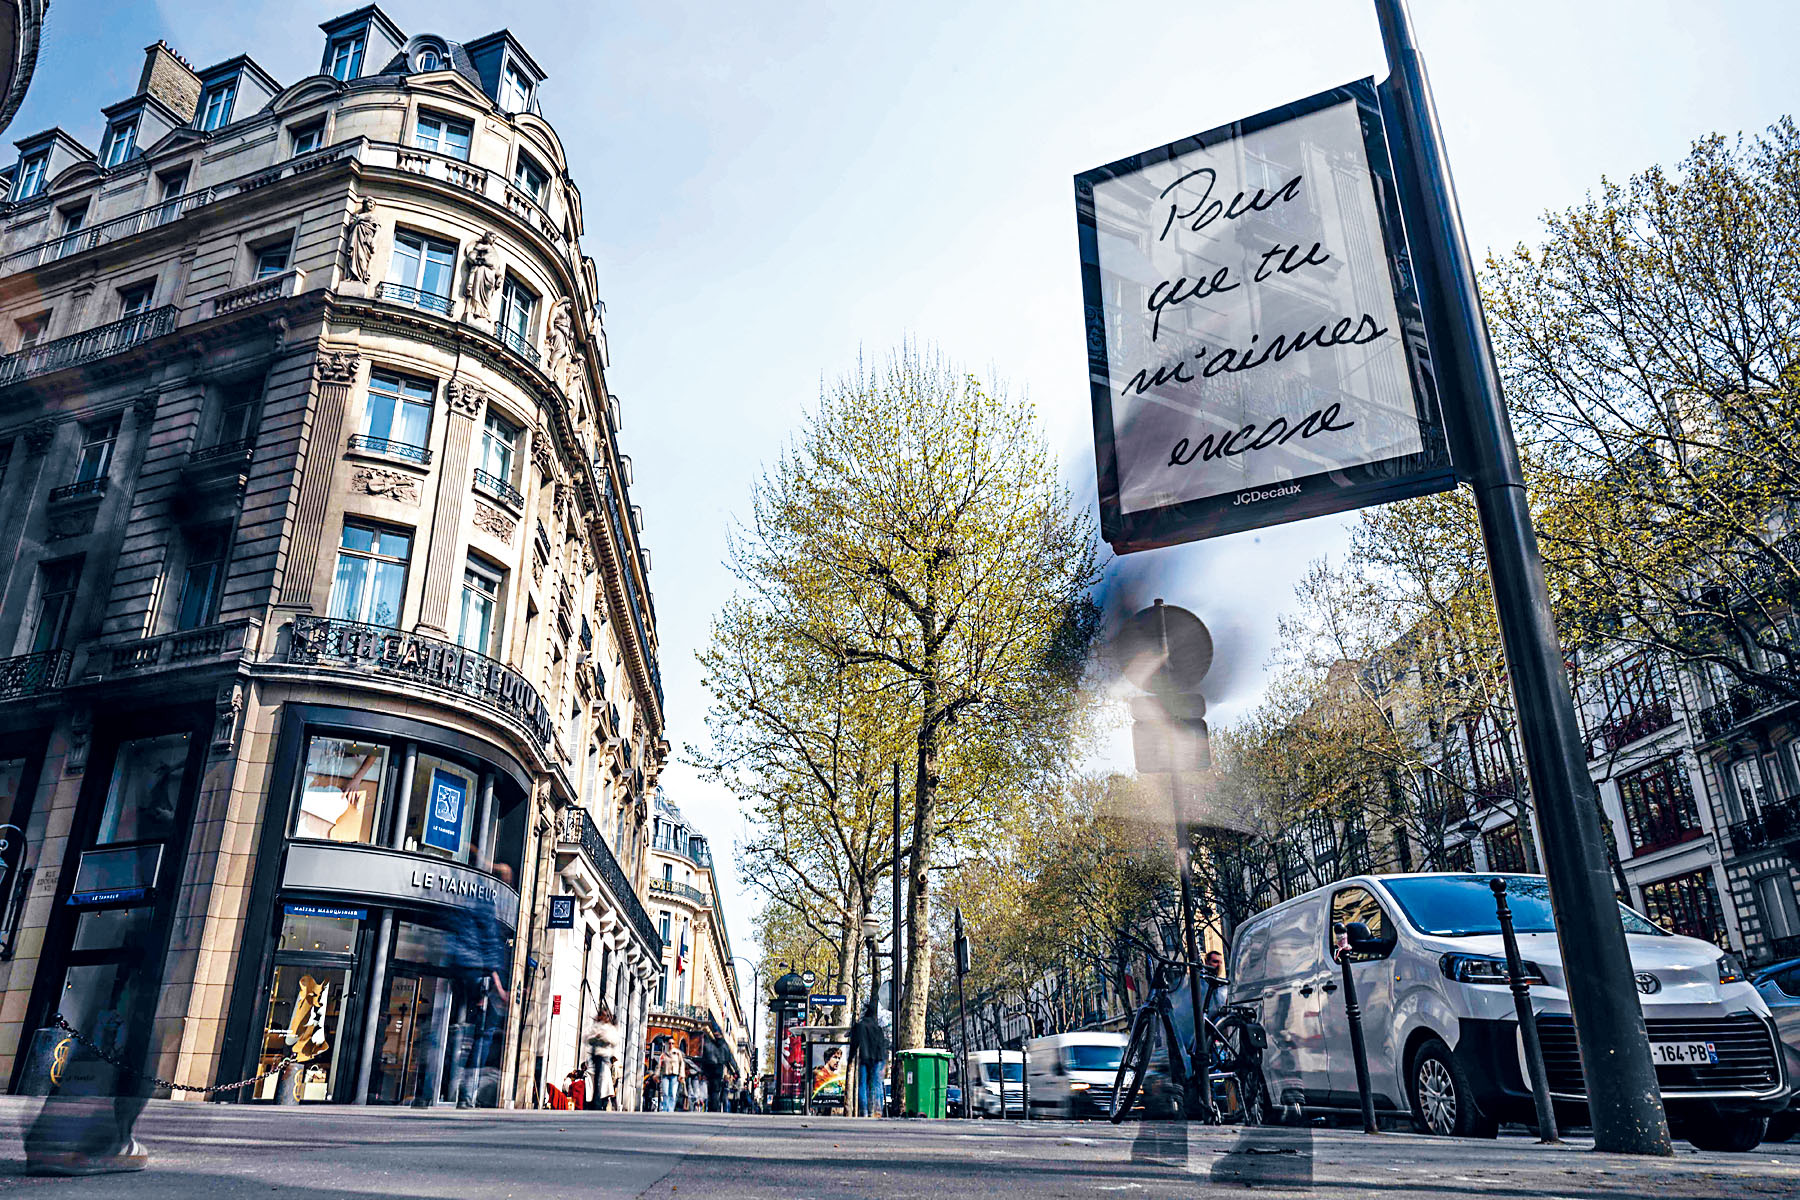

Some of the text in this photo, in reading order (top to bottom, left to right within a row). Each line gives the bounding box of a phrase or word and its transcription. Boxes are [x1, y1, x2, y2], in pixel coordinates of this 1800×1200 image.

[1160, 168, 1302, 241] Pour
[1147, 242, 1329, 342] que tu
[1121, 313, 1388, 396] m'aimes
[1168, 402, 1354, 467] encore
[1233, 484, 1302, 506] JCDecaux
[411, 870, 498, 905] LE TANNEUR
